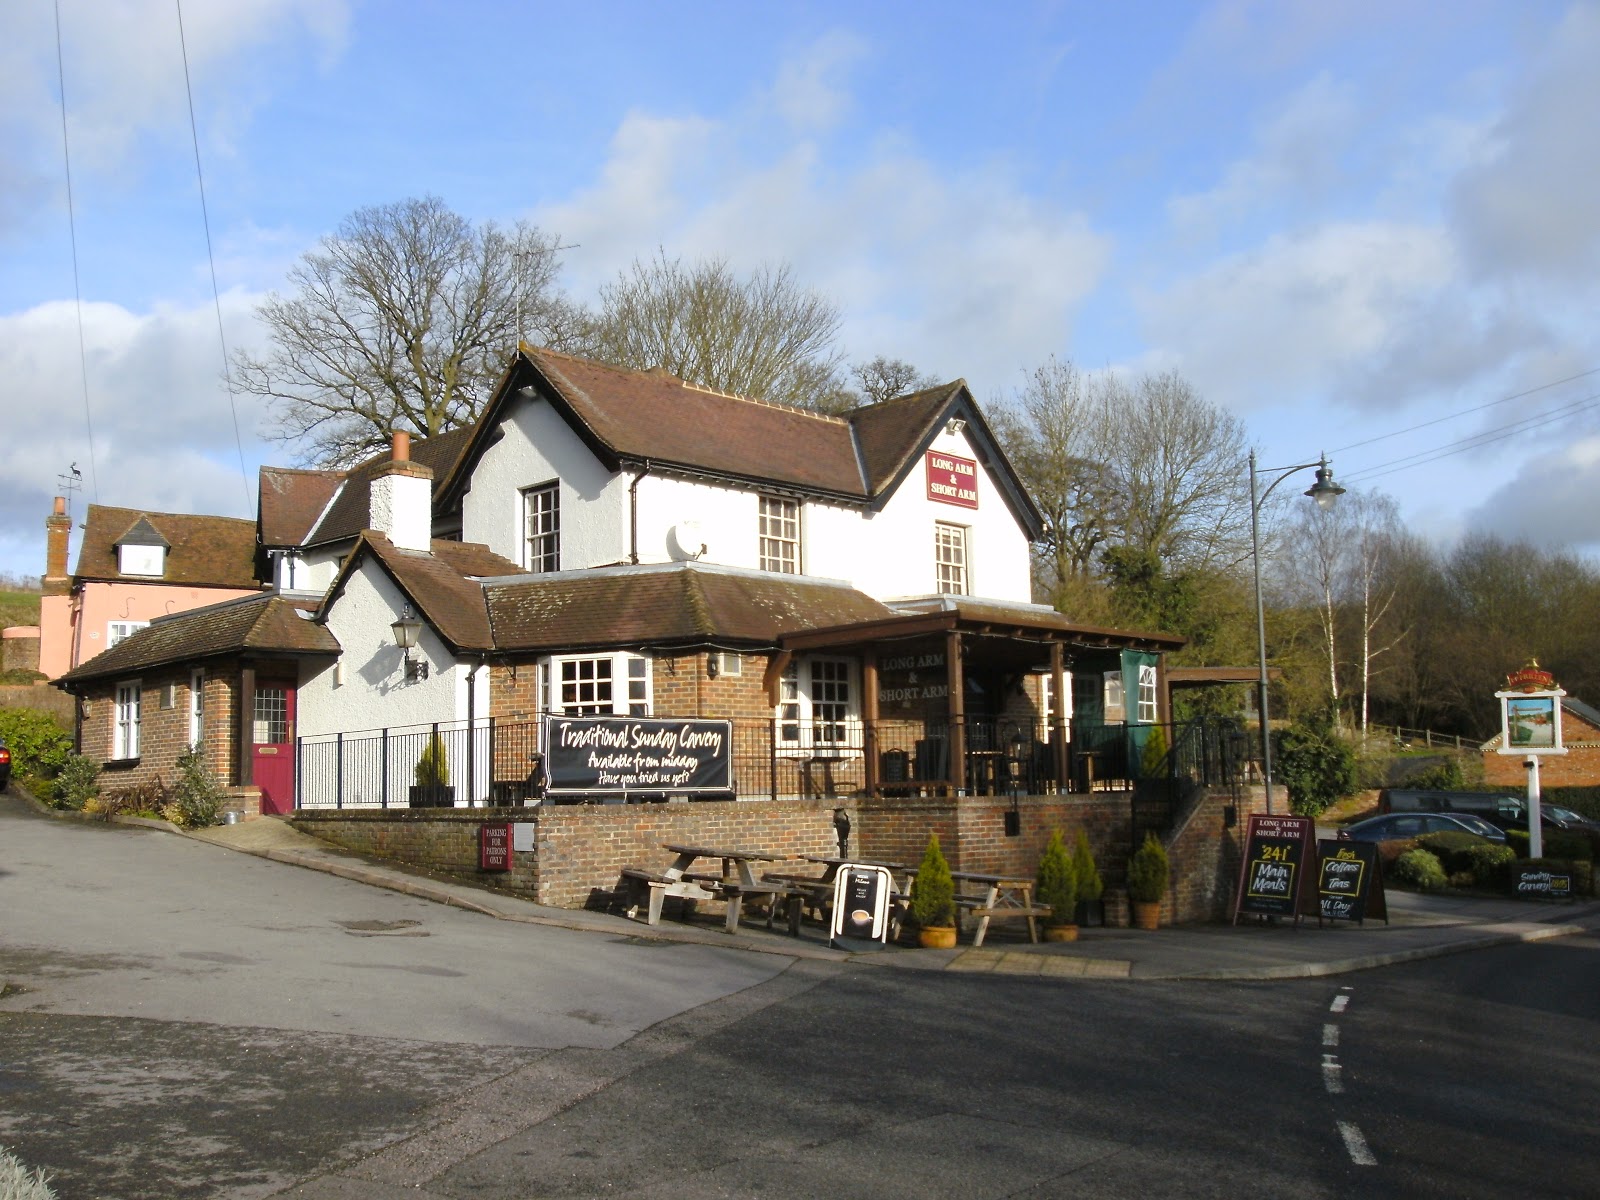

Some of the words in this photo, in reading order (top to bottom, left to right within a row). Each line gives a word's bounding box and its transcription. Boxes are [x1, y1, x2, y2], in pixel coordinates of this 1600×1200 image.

[932, 457, 953, 471] LONG
[955, 463, 973, 476] ARM
[950, 474, 957, 485] &
[931, 482, 957, 497] SHORT
[958, 488, 976, 501] ARM
[883, 656, 915, 671] LONG
[917, 654, 944, 667] ARM
[909, 672, 918, 683] &
[879, 687, 919, 702] SHORT
[922, 685, 948, 699] ARM
[560, 722, 629, 748] Traditional
[631, 724, 678, 757] Sunday
[679, 725, 722, 757] Carvery
[588, 751, 632, 767] Available
[633, 752, 659, 772] from
[661, 754, 698, 772] midday
[599, 770, 618, 784] Have
[621, 774, 637, 789] you
[638, 771, 658, 784] tried
[660, 773, 670, 783] us
[672, 770, 690, 787] yet?
[486, 829, 507, 837] PARKING
[491, 838, 501, 846] FOR
[486, 847, 507, 855] PATRONS
[490, 856, 503, 865] ONLY
[1257, 863, 1288, 878] Main
[1252, 877, 1287, 893] Meals
